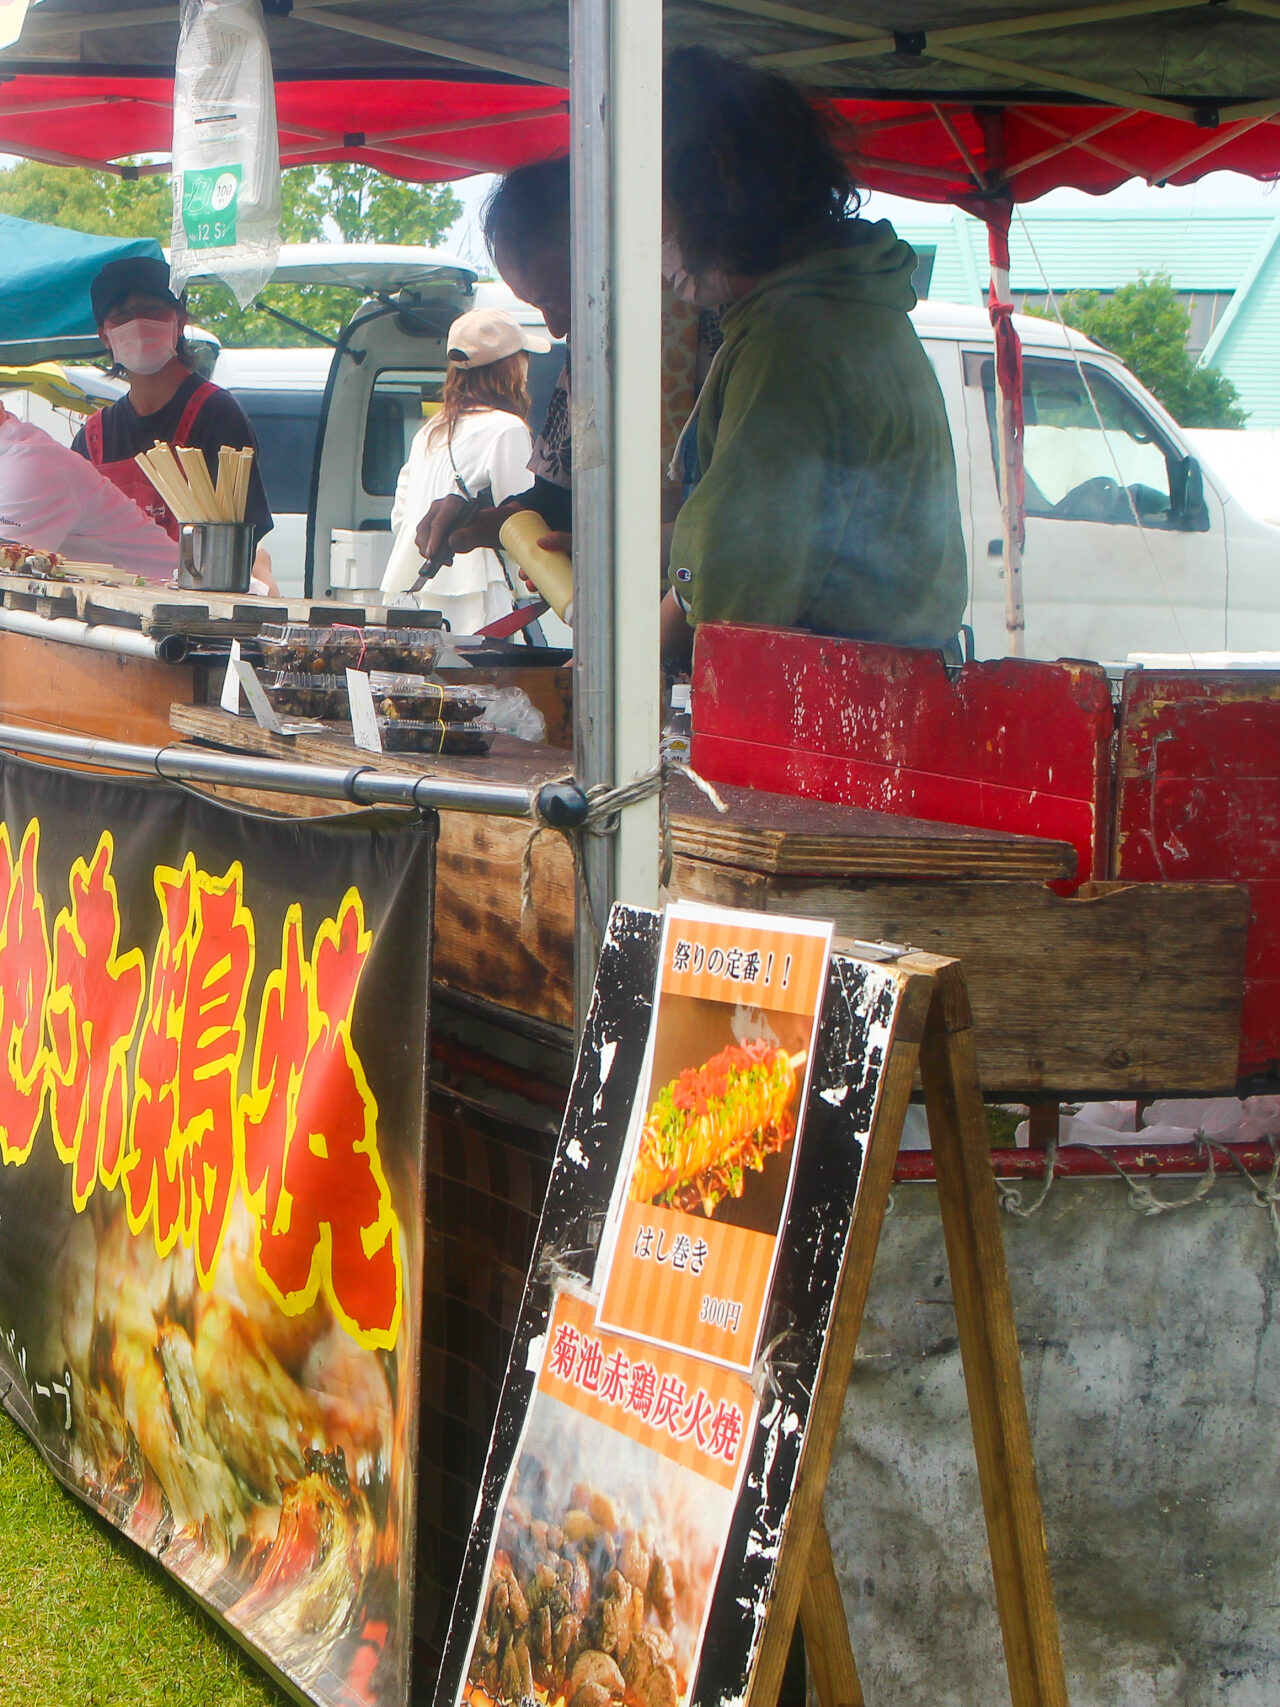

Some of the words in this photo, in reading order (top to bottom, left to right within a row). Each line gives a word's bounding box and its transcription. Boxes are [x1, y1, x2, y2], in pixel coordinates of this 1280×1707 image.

[634, 1226, 708, 1274] はし巻き
[700, 1295, 742, 1332] 300円
[549, 1324, 743, 1462] 菊池赤鶏炭火焼
